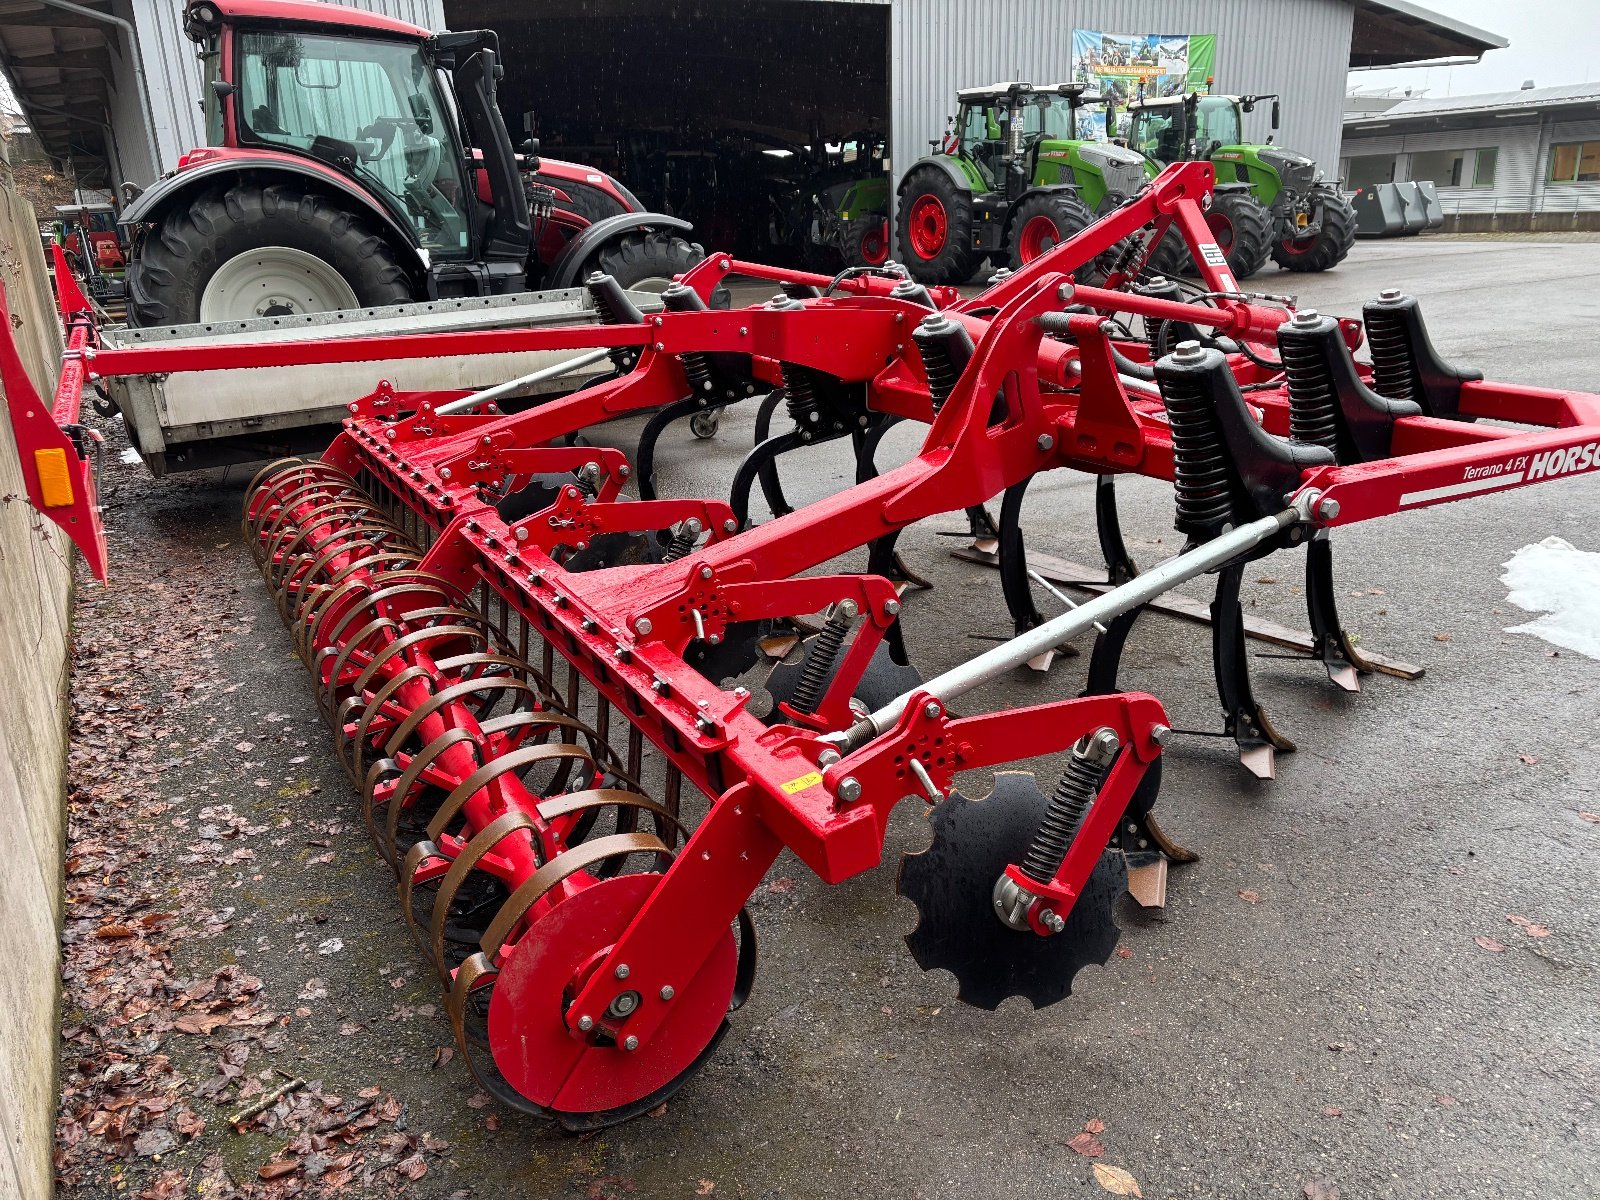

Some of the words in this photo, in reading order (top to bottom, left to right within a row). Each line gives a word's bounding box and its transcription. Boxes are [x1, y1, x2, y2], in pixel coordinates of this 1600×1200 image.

[1463, 463, 1503, 480] Terrano
[1505, 458, 1513, 472] 4
[1513, 455, 1529, 471] FX
